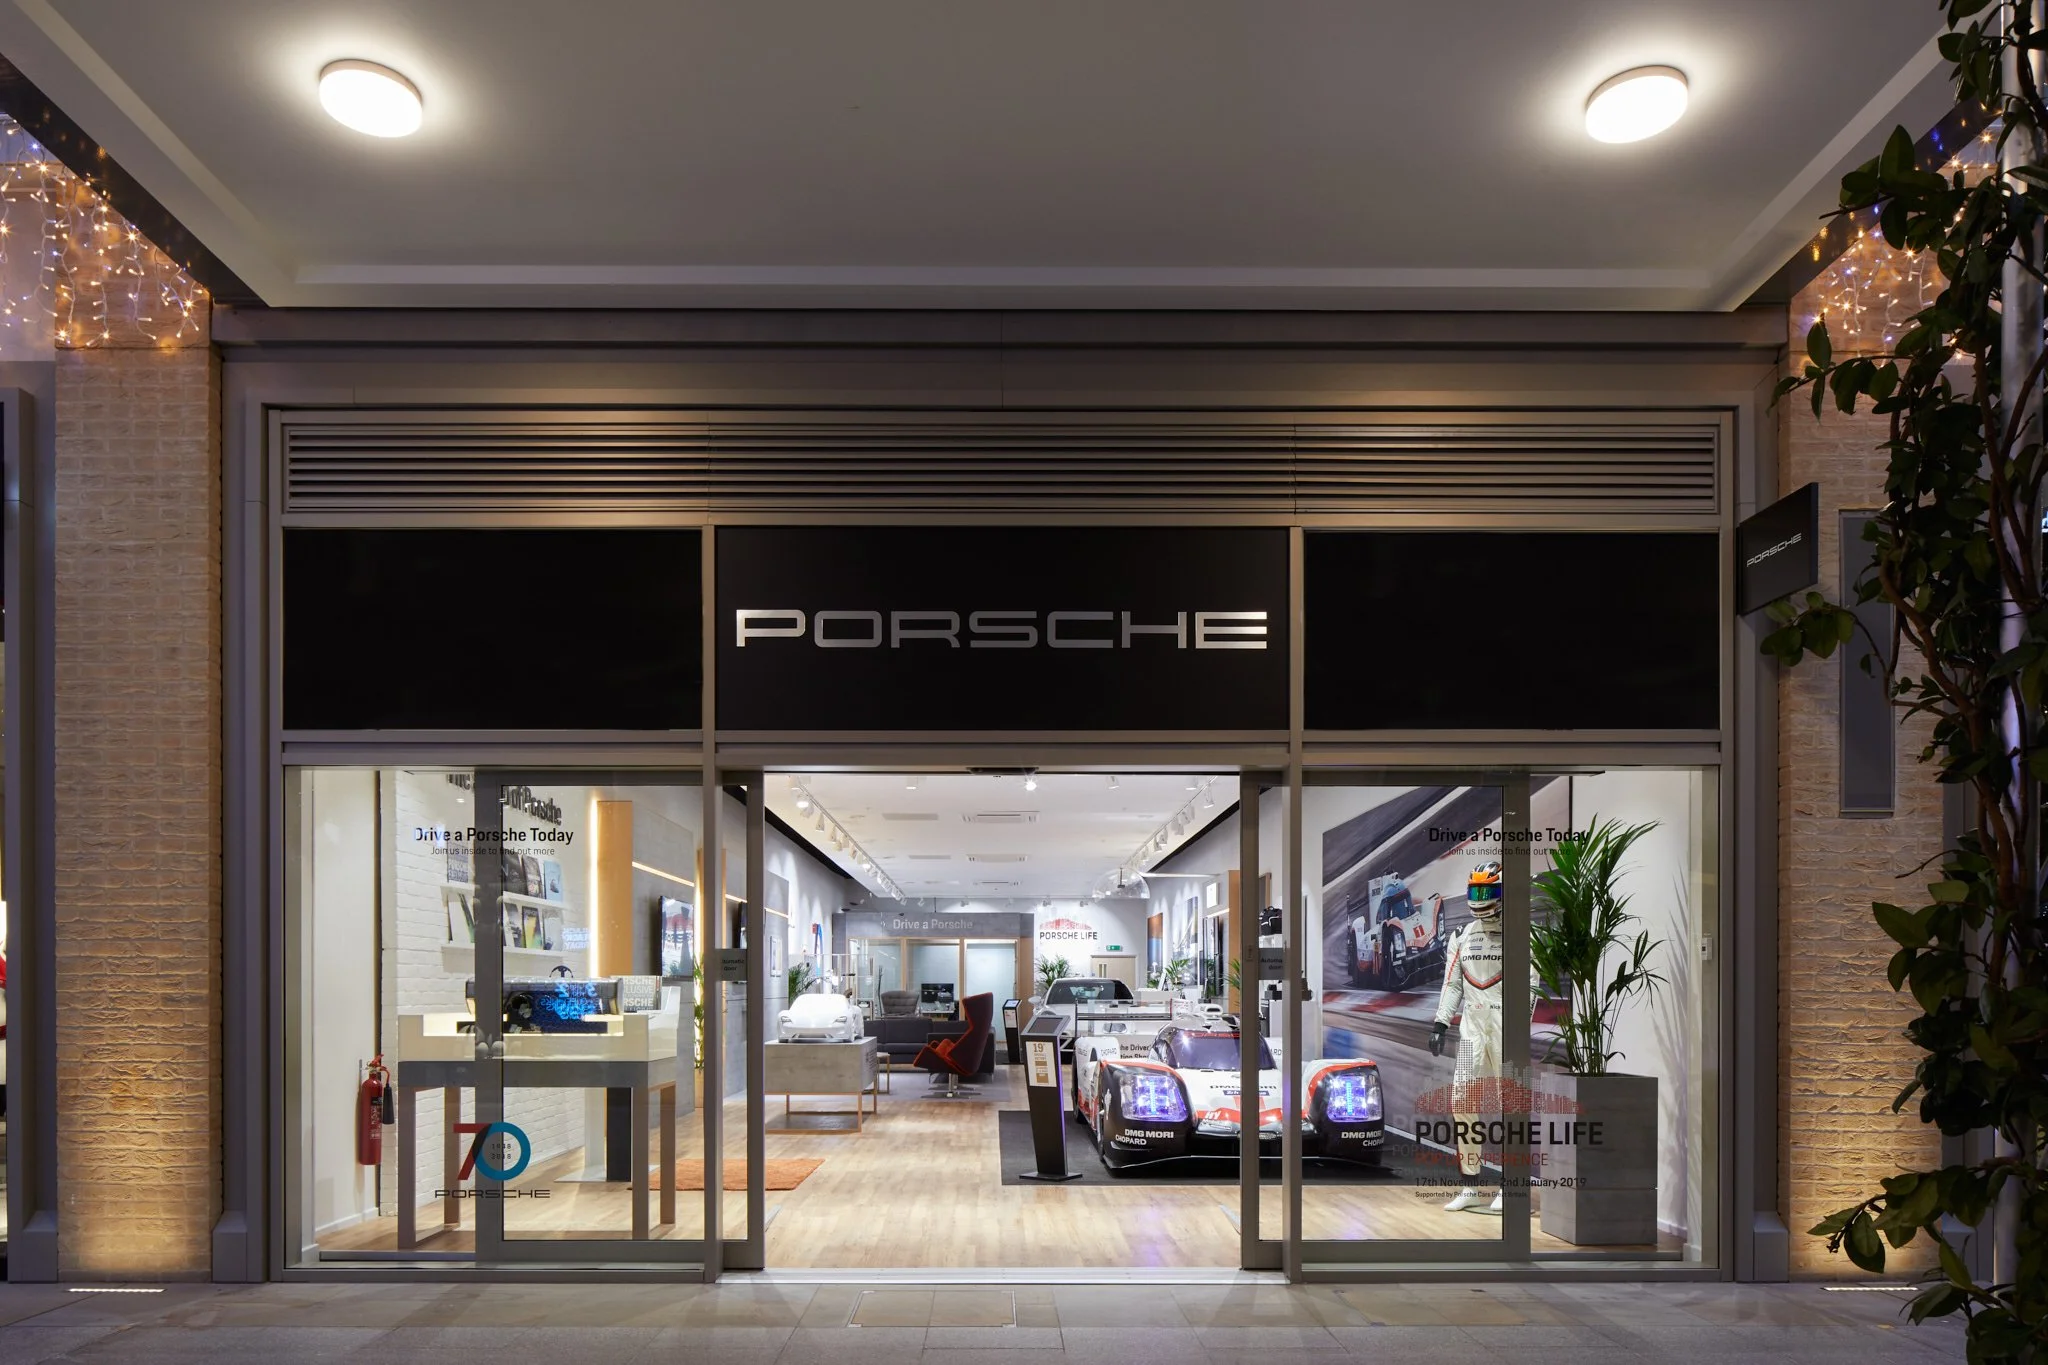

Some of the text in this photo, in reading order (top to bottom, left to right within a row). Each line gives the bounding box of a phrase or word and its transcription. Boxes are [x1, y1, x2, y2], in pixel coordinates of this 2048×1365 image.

[1746, 533, 1802, 567] PORSCHE
[736, 609, 1267, 649] PORSCHE
[415, 827, 574, 845] Drive a Porsche Today
[1429, 827, 1590, 846] Drive a Porsche Today
[431, 847, 448, 856] Join
[450, 848, 460, 856] us
[461, 847, 486, 856] inside
[488, 848, 498, 856] to
[517, 848, 532, 856] out
[533, 848, 555, 856] more
[1450, 847, 1464, 856] Join
[1466, 848, 1476, 856] us
[1477, 847, 1503, 856] inside
[1505, 848, 1514, 856] to
[1515, 847, 1531, 856] find
[1533, 848, 1548, 856] out
[893, 919, 974, 929] Drive a Porsche
[1039, 931, 1098, 940] PORSCHE LIFE
[623, 999, 654, 1007] RSCHE
[1124, 1128, 1174, 1139] DMG MORI
[1415, 1121, 1541, 1145] PORSCHE
[1550, 1121, 1603, 1145] LIFE
[1115, 1134, 1147, 1145] CHOPARD
[453, 1122, 531, 1180] 70
[1445, 1152, 1464, 1166] UP
[1467, 1152, 1548, 1166] EXPERIENCE
[1415, 1177, 1438, 1187] 17th
[1440, 1177, 1489, 1187] November
[1501, 1177, 1519, 1187] 2nd
[1521, 1177, 1558, 1190] January
[1560, 1177, 1588, 1187] 2019
[434, 1189, 551, 1199] PORSCHE
